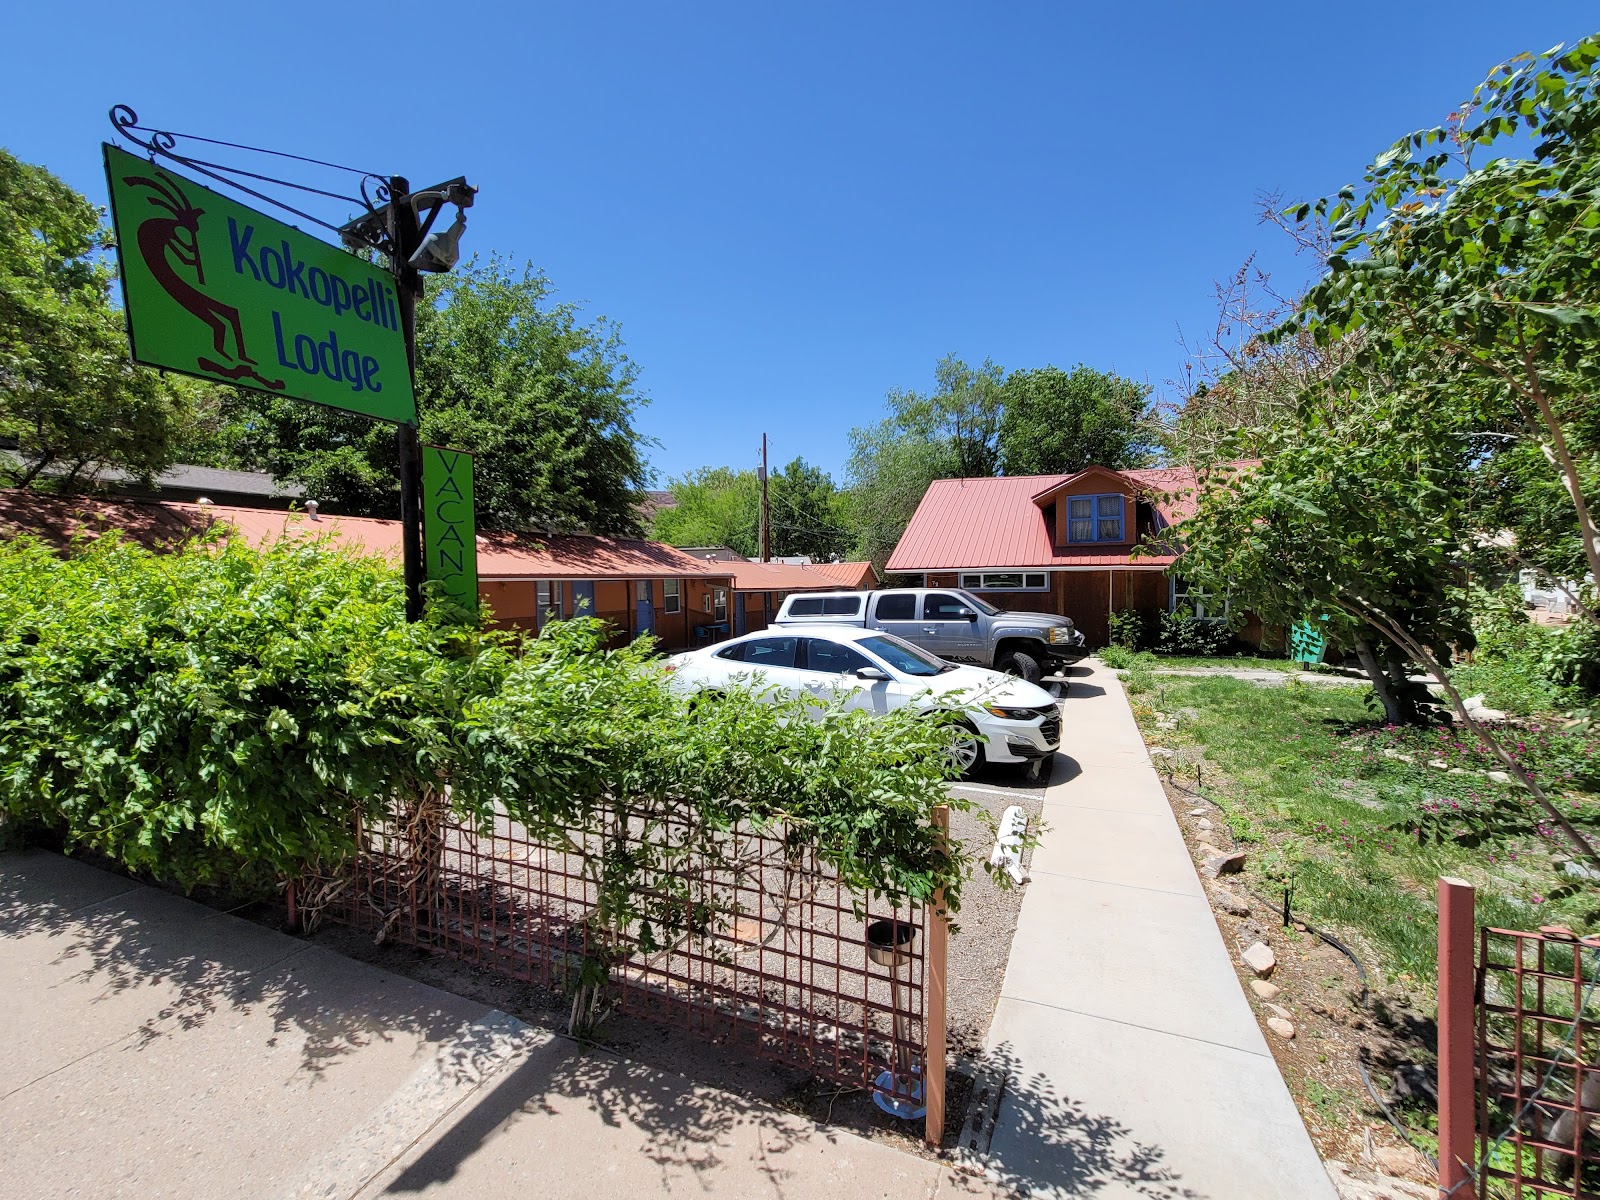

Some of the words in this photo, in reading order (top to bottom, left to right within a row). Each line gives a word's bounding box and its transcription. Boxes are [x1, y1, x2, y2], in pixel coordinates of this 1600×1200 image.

[227, 216, 398, 332] Kokopelli
[272, 311, 382, 392] Lodge
[435, 450, 467, 606] VACANC
